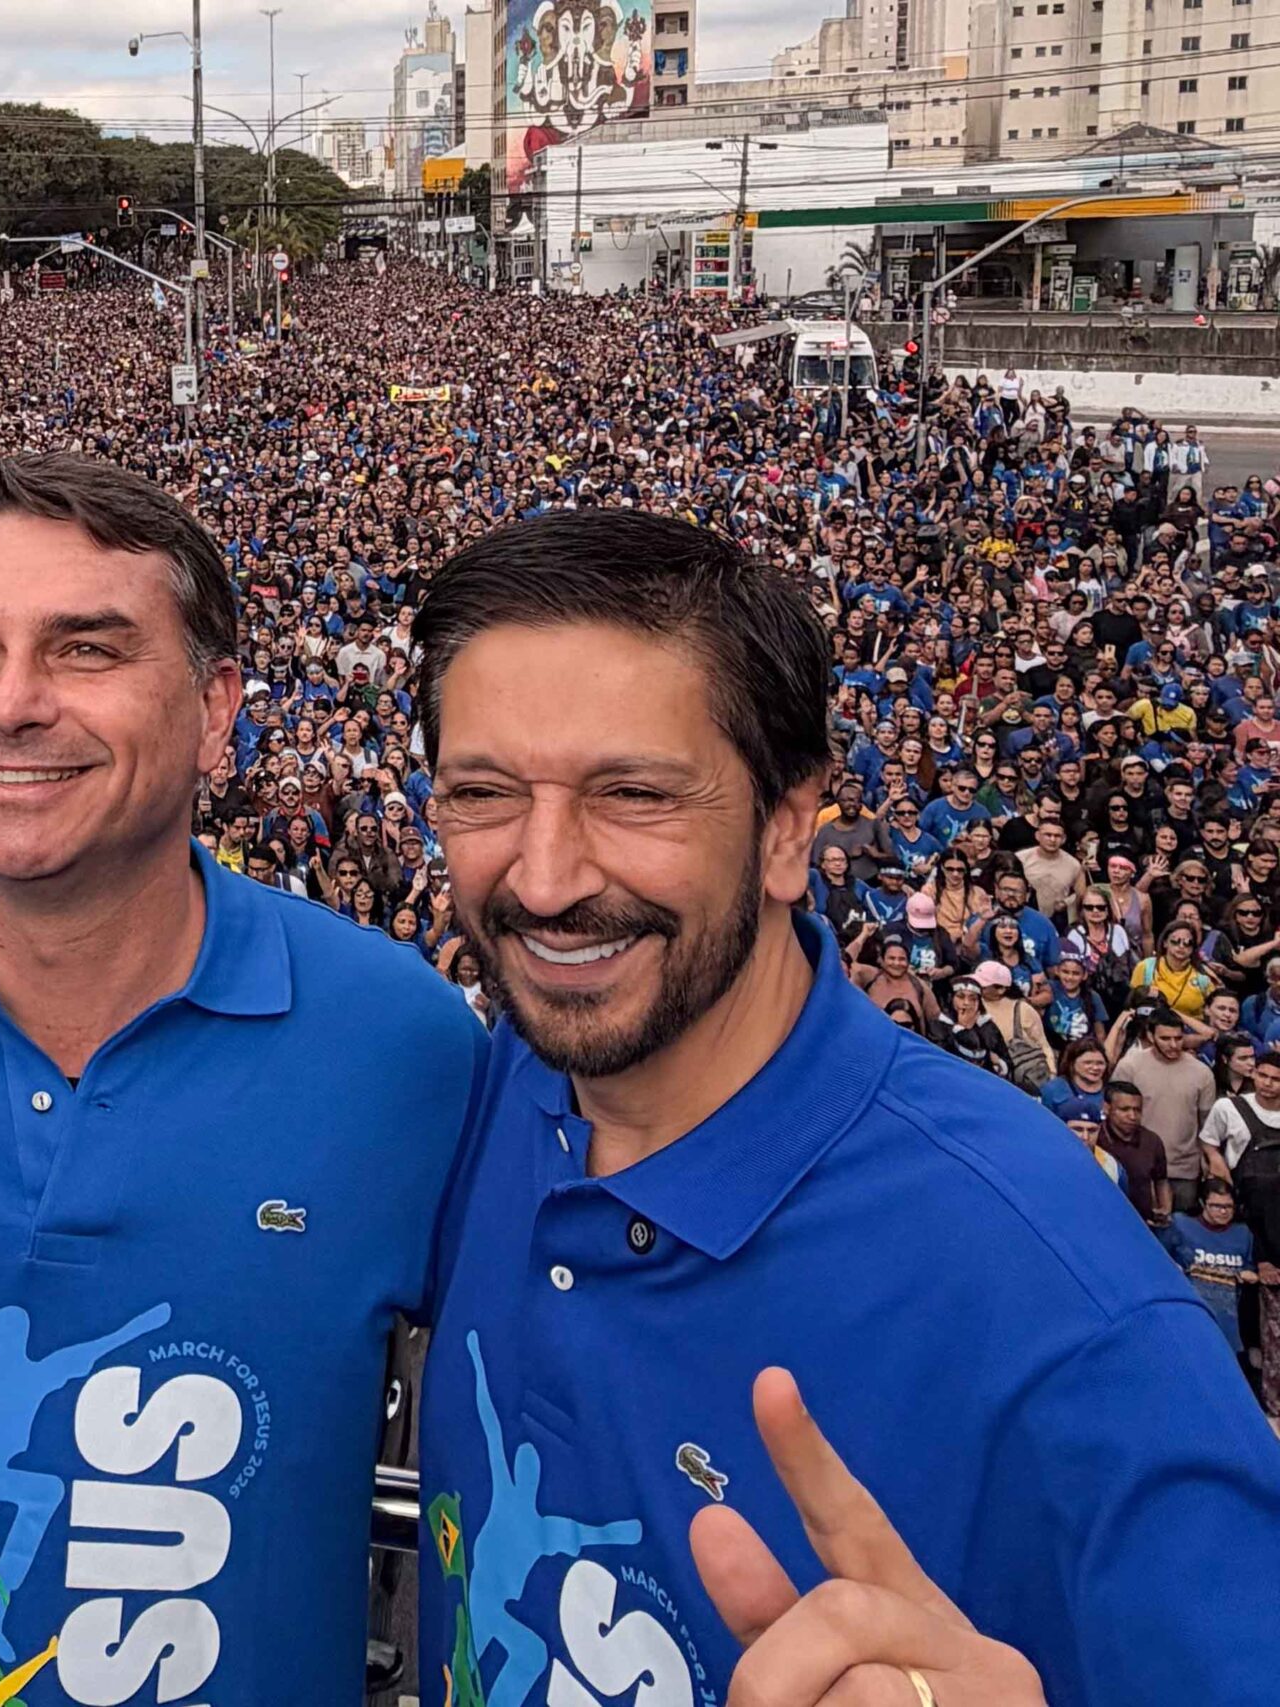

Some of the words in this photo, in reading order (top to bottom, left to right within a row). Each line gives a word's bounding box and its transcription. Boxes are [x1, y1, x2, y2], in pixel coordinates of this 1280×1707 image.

[1194, 1249, 1243, 1266] Jesus
[148, 1340, 226, 1364] MARCH
[225, 1354, 259, 1391] FOR
[251, 1389, 272, 1452] JESUS
[228, 1453, 264, 1500] 2026
[57, 1366, 243, 1707] SUS
[620, 1564, 679, 1622] MARCH
[679, 1623, 707, 1683] FOR
